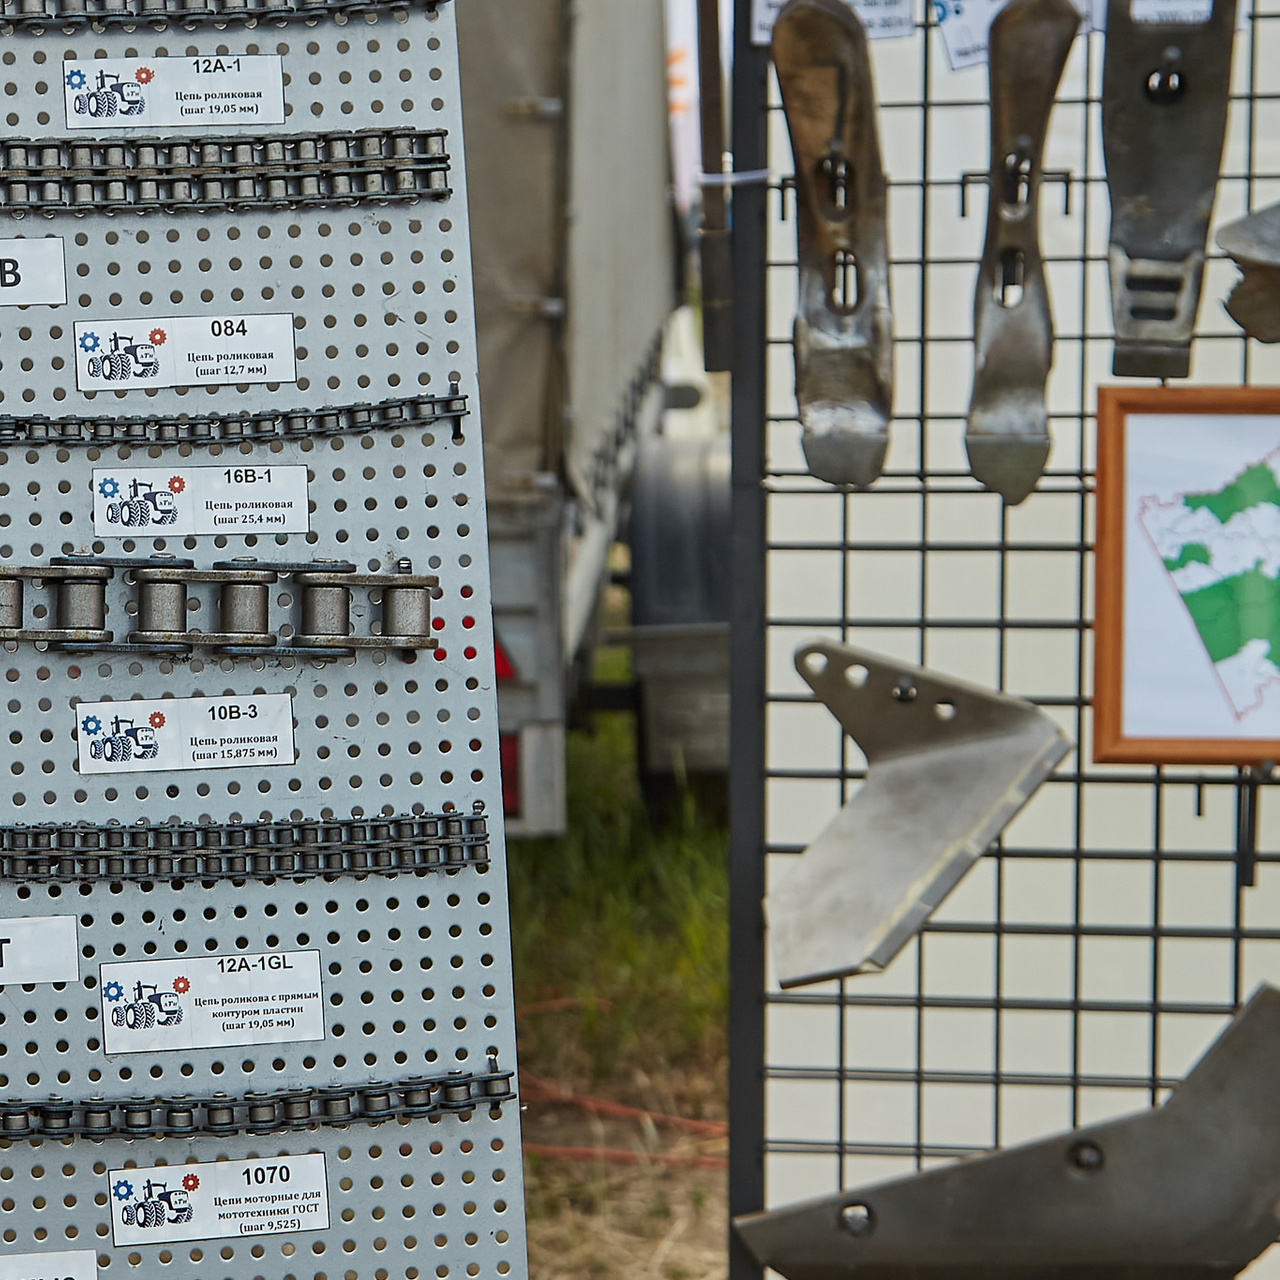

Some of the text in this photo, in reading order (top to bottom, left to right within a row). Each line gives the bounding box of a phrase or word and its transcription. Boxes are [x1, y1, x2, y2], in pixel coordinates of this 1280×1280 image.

[192, 58, 240, 74] 12A-1
[175, 91, 262, 102] Цепь роликовая
[180, 103, 259, 117] (шаг 19,05 мм)
[211, 319, 248, 337] 084
[187, 352, 274, 363] Цепь роликовая
[195, 364, 267, 378] (шаг 12,7 мм)
[224, 468, 271, 484] 16B-1
[205, 500, 293, 511] Цепь роликовая
[214, 513, 286, 526] (шаг 25,4 мм)
[208, 704, 258, 721] 10B-3
[190, 735, 278, 747] Цепь роликовая
[192, 747, 277, 762] (шаг 15,875 мм)
[217, 955, 293, 973] 12A-1GL
[194, 998, 220, 1008] Цепь
[221, 995, 269, 1007] роликова
[278, 992, 319, 1003] прямым
[212, 1006, 303, 1019] контуром пластин
[222, 1017, 295, 1032] (шаг 19,05 мм)
[242, 1165, 290, 1185] 1070
[214, 1191, 321, 1207] Цепи моторные для
[218, 1203, 319, 1220] мототехники ГОСТ
[239, 1218, 301, 1234] (шаг 9,525)
